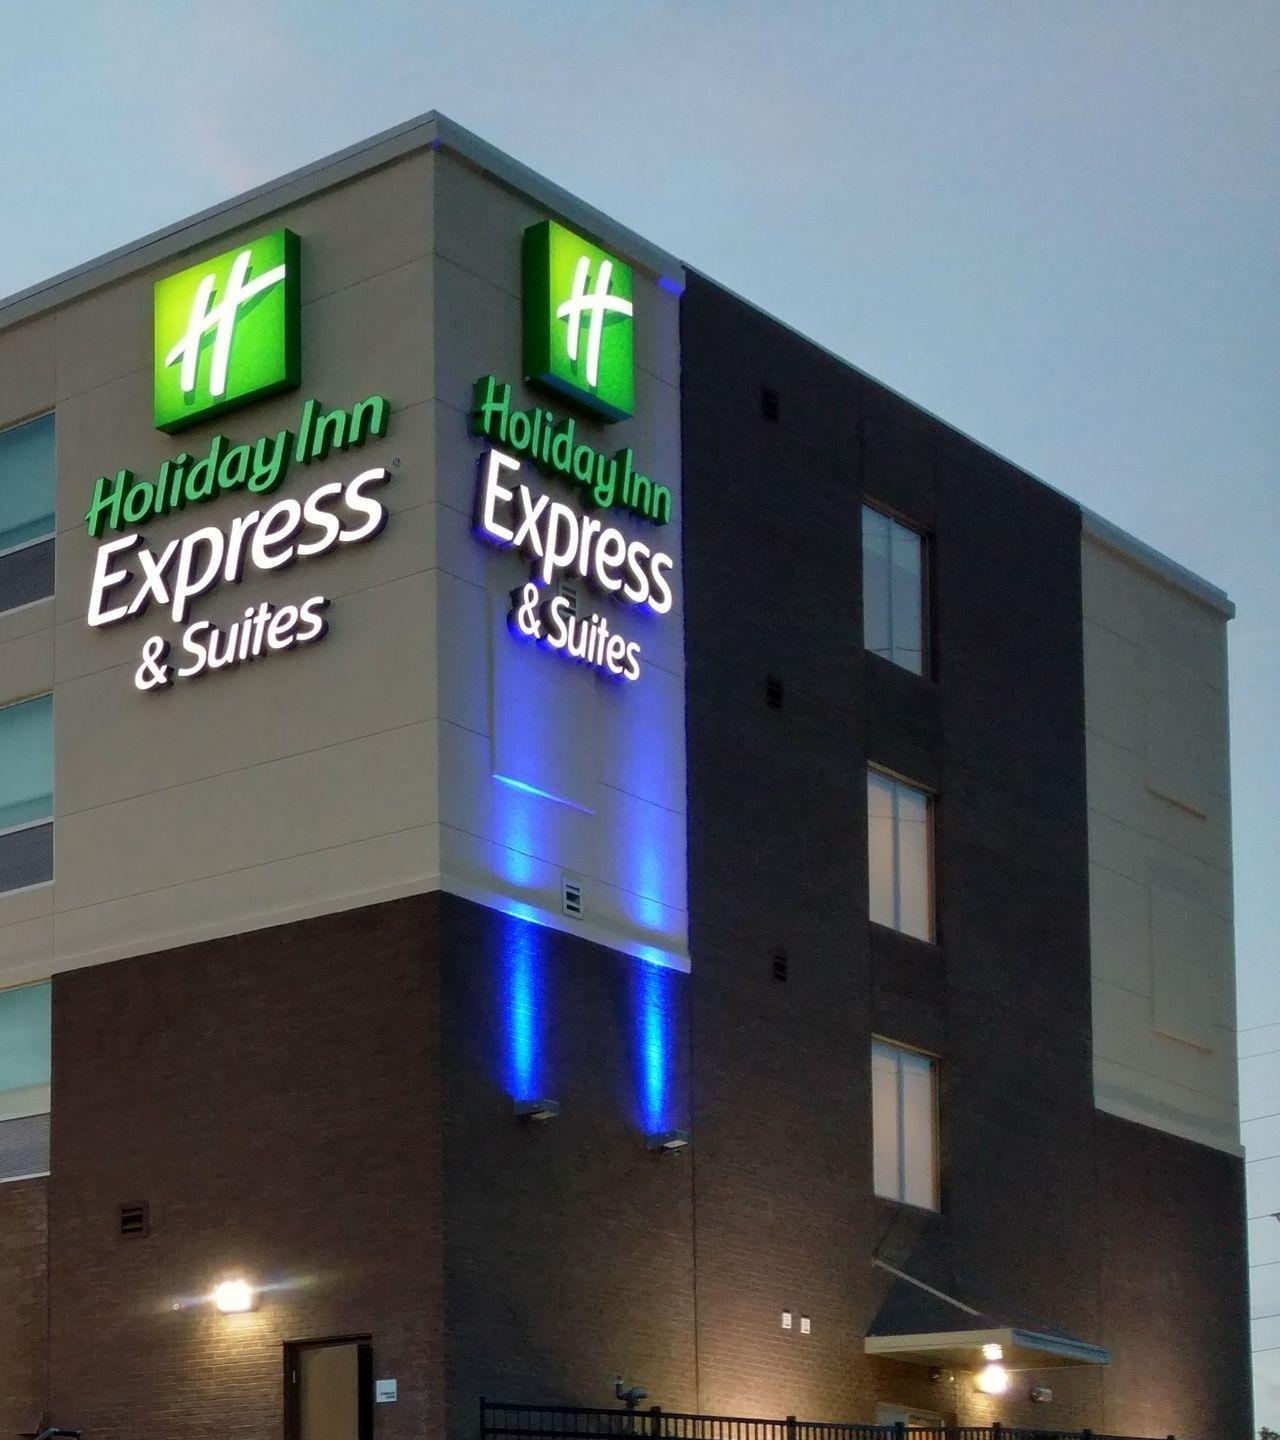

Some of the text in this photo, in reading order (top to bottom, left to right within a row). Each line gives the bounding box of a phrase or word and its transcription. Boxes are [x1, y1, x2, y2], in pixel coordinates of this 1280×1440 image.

[85, 395, 385, 536] Holiday Inn
[482, 375, 672, 524] Holiday Inn
[87, 467, 387, 627] Express
[484, 448, 674, 614] Express
[134, 596, 326, 691] & Suites
[517, 582, 642, 682] & Suites
